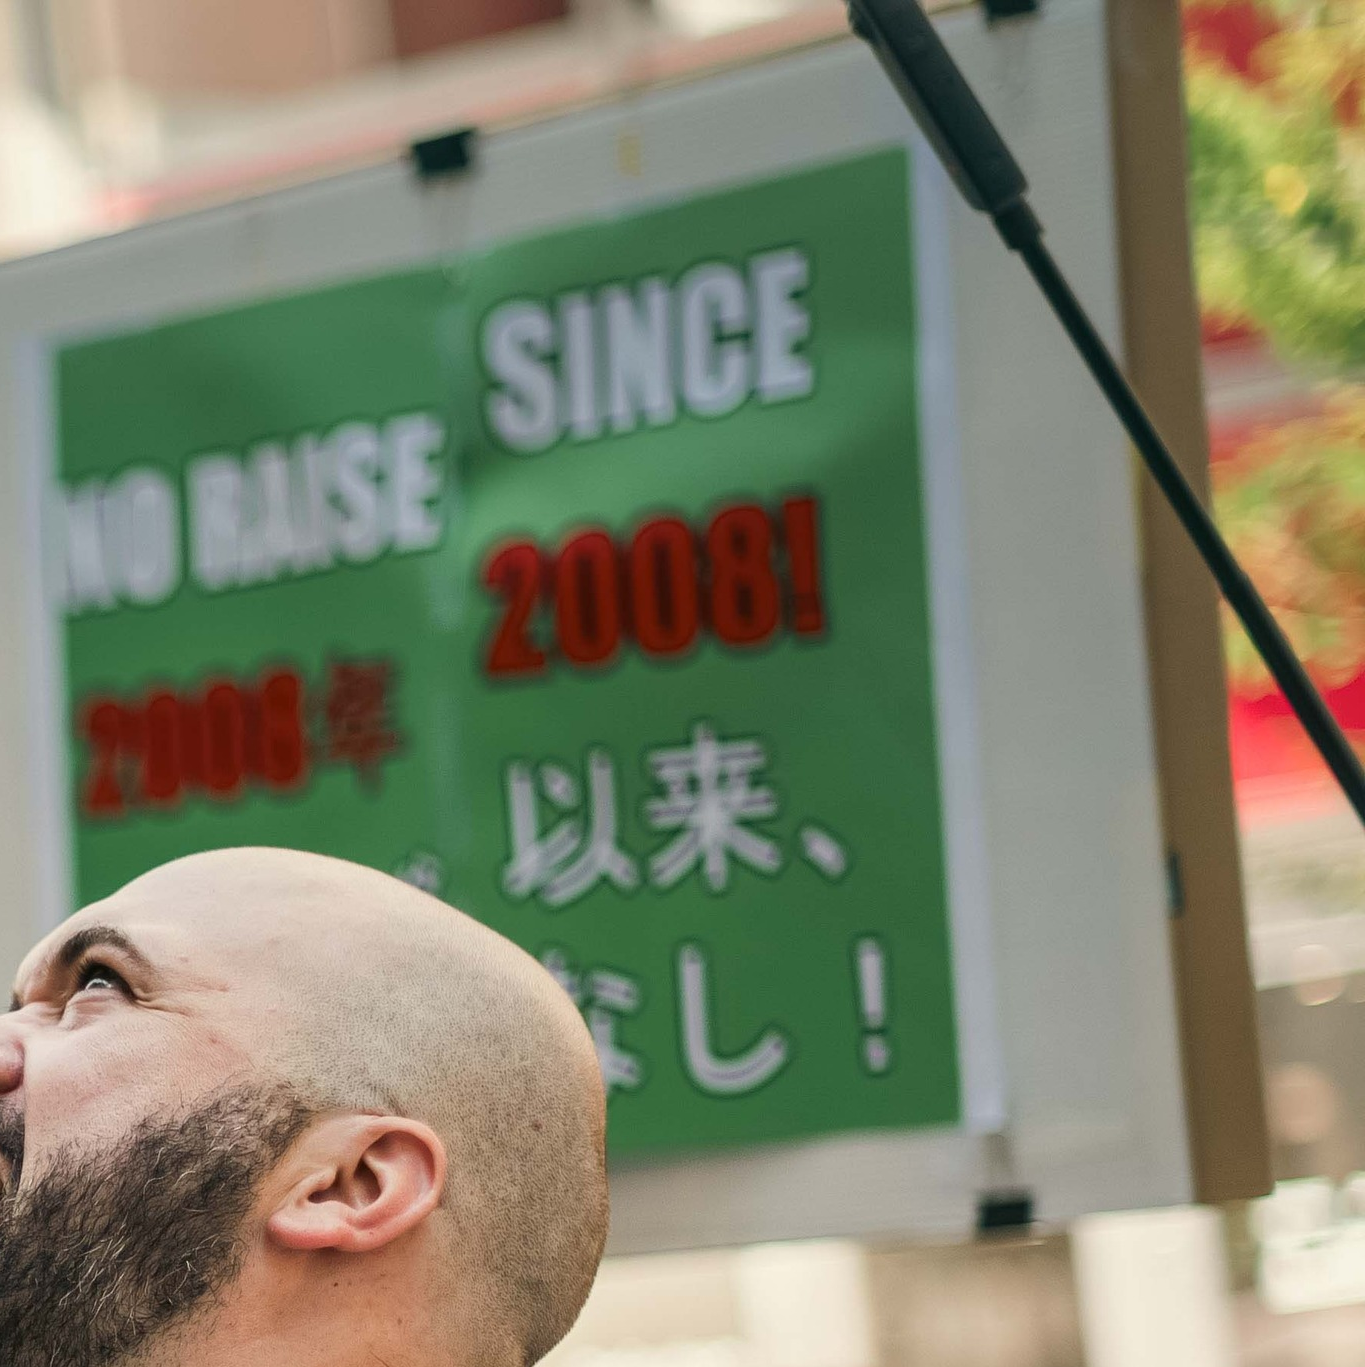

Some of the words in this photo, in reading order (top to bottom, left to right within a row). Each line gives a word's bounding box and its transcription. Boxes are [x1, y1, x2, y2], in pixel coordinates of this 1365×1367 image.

[481, 247, 814, 454] SINCE
[49, 465, 177, 613] NO
[183, 408, 447, 596] RAISE
[485, 494, 825, 678] 2008!
[502, 720, 847, 906] 以来、
